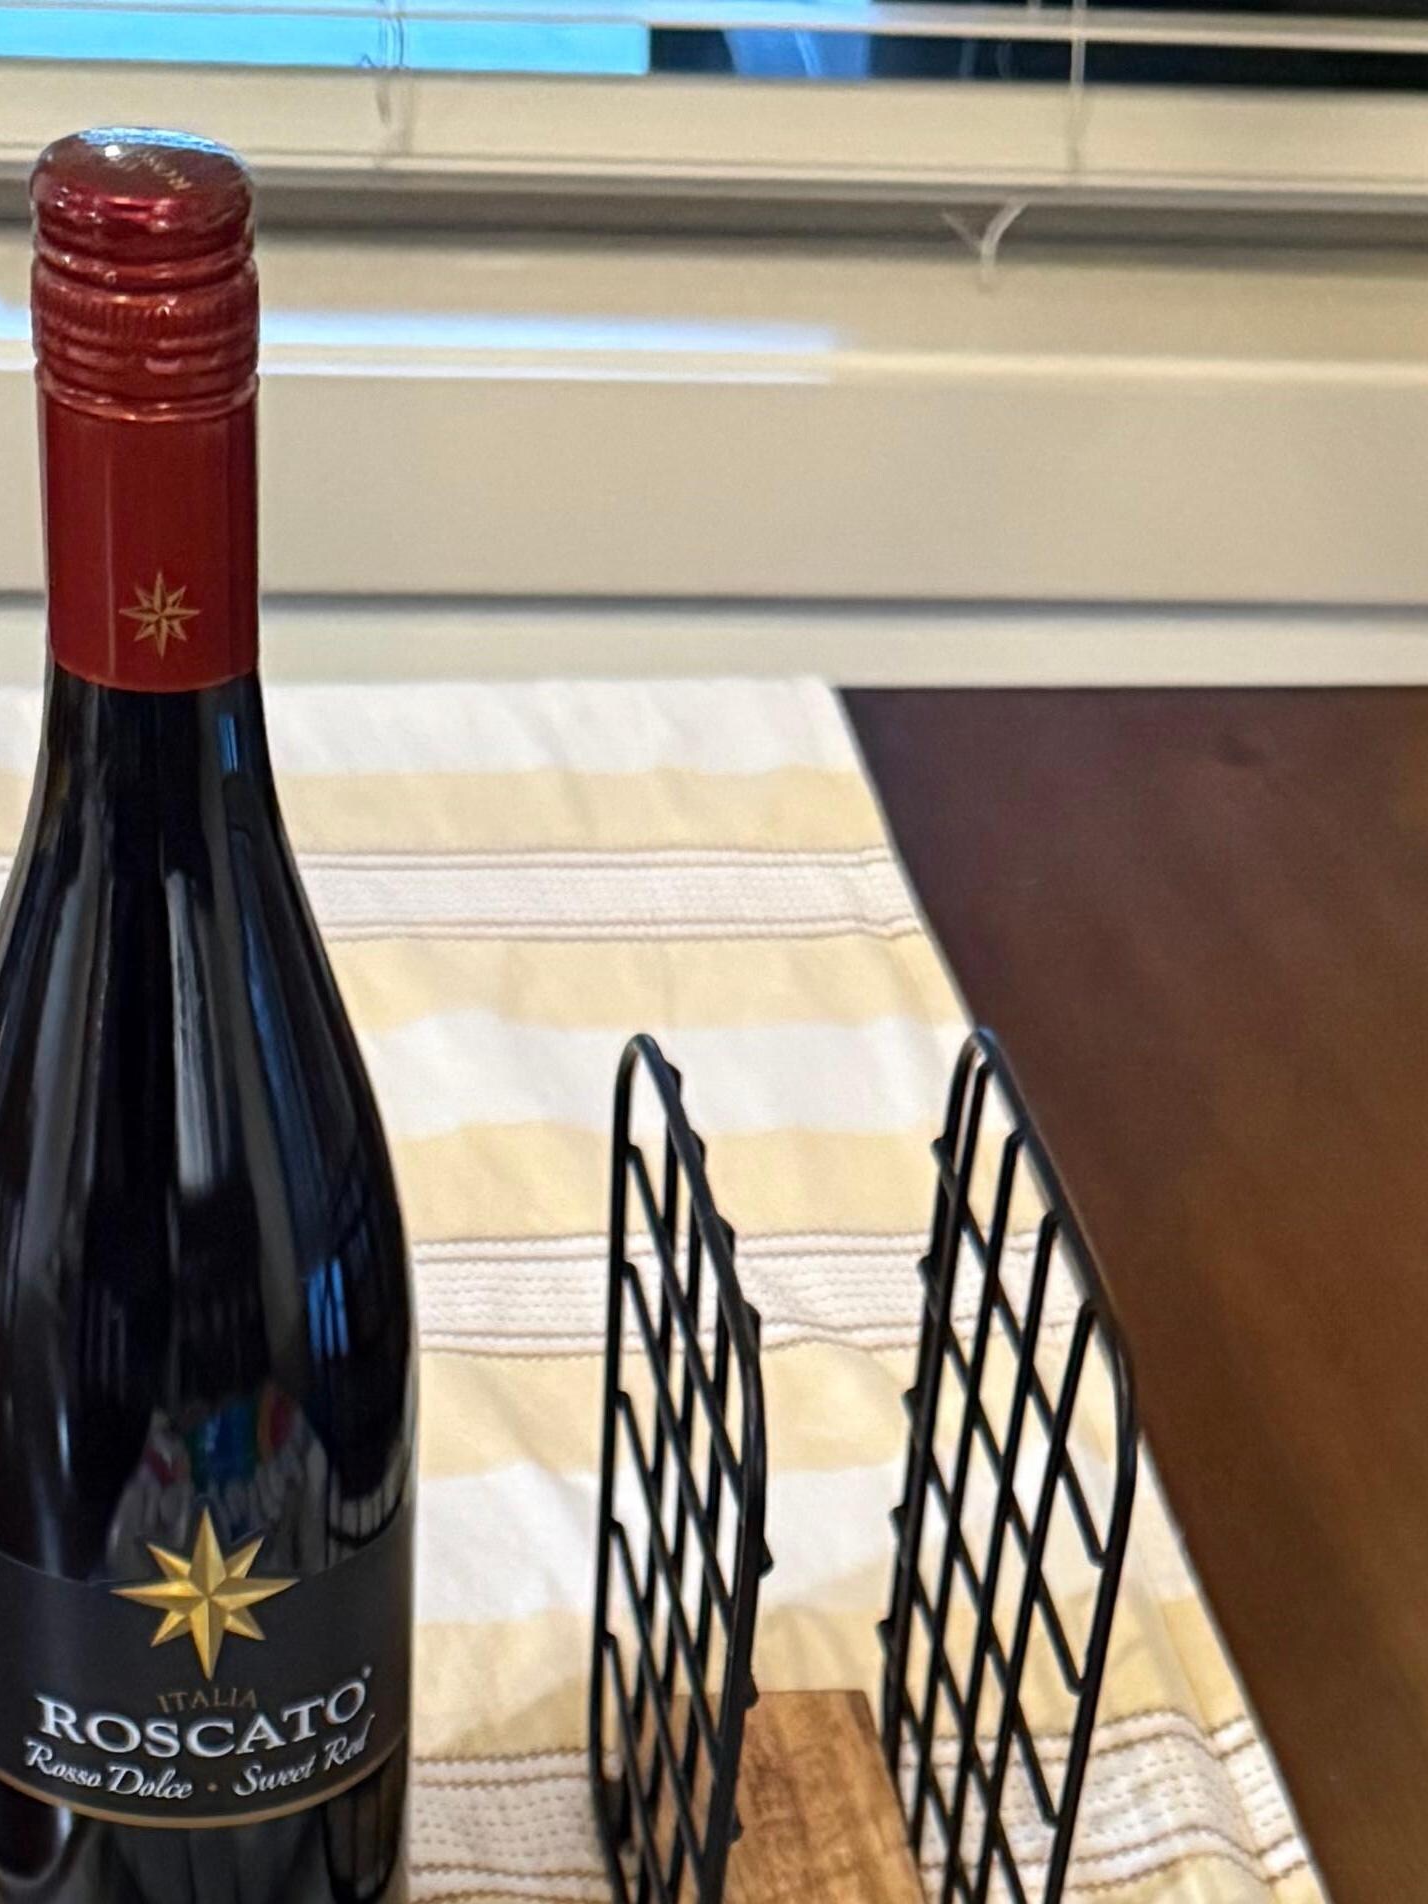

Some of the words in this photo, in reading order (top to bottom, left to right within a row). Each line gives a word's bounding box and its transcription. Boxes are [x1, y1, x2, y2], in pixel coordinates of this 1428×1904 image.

[34, 1680, 368, 1760] ROSCATO
[157, 1688, 258, 1716] ITALIA
[24, 1737, 102, 1788] Rosso
[105, 1764, 195, 1800] Dolce
[232, 1754, 316, 1798] Sweet
[322, 1712, 375, 1774] Red
